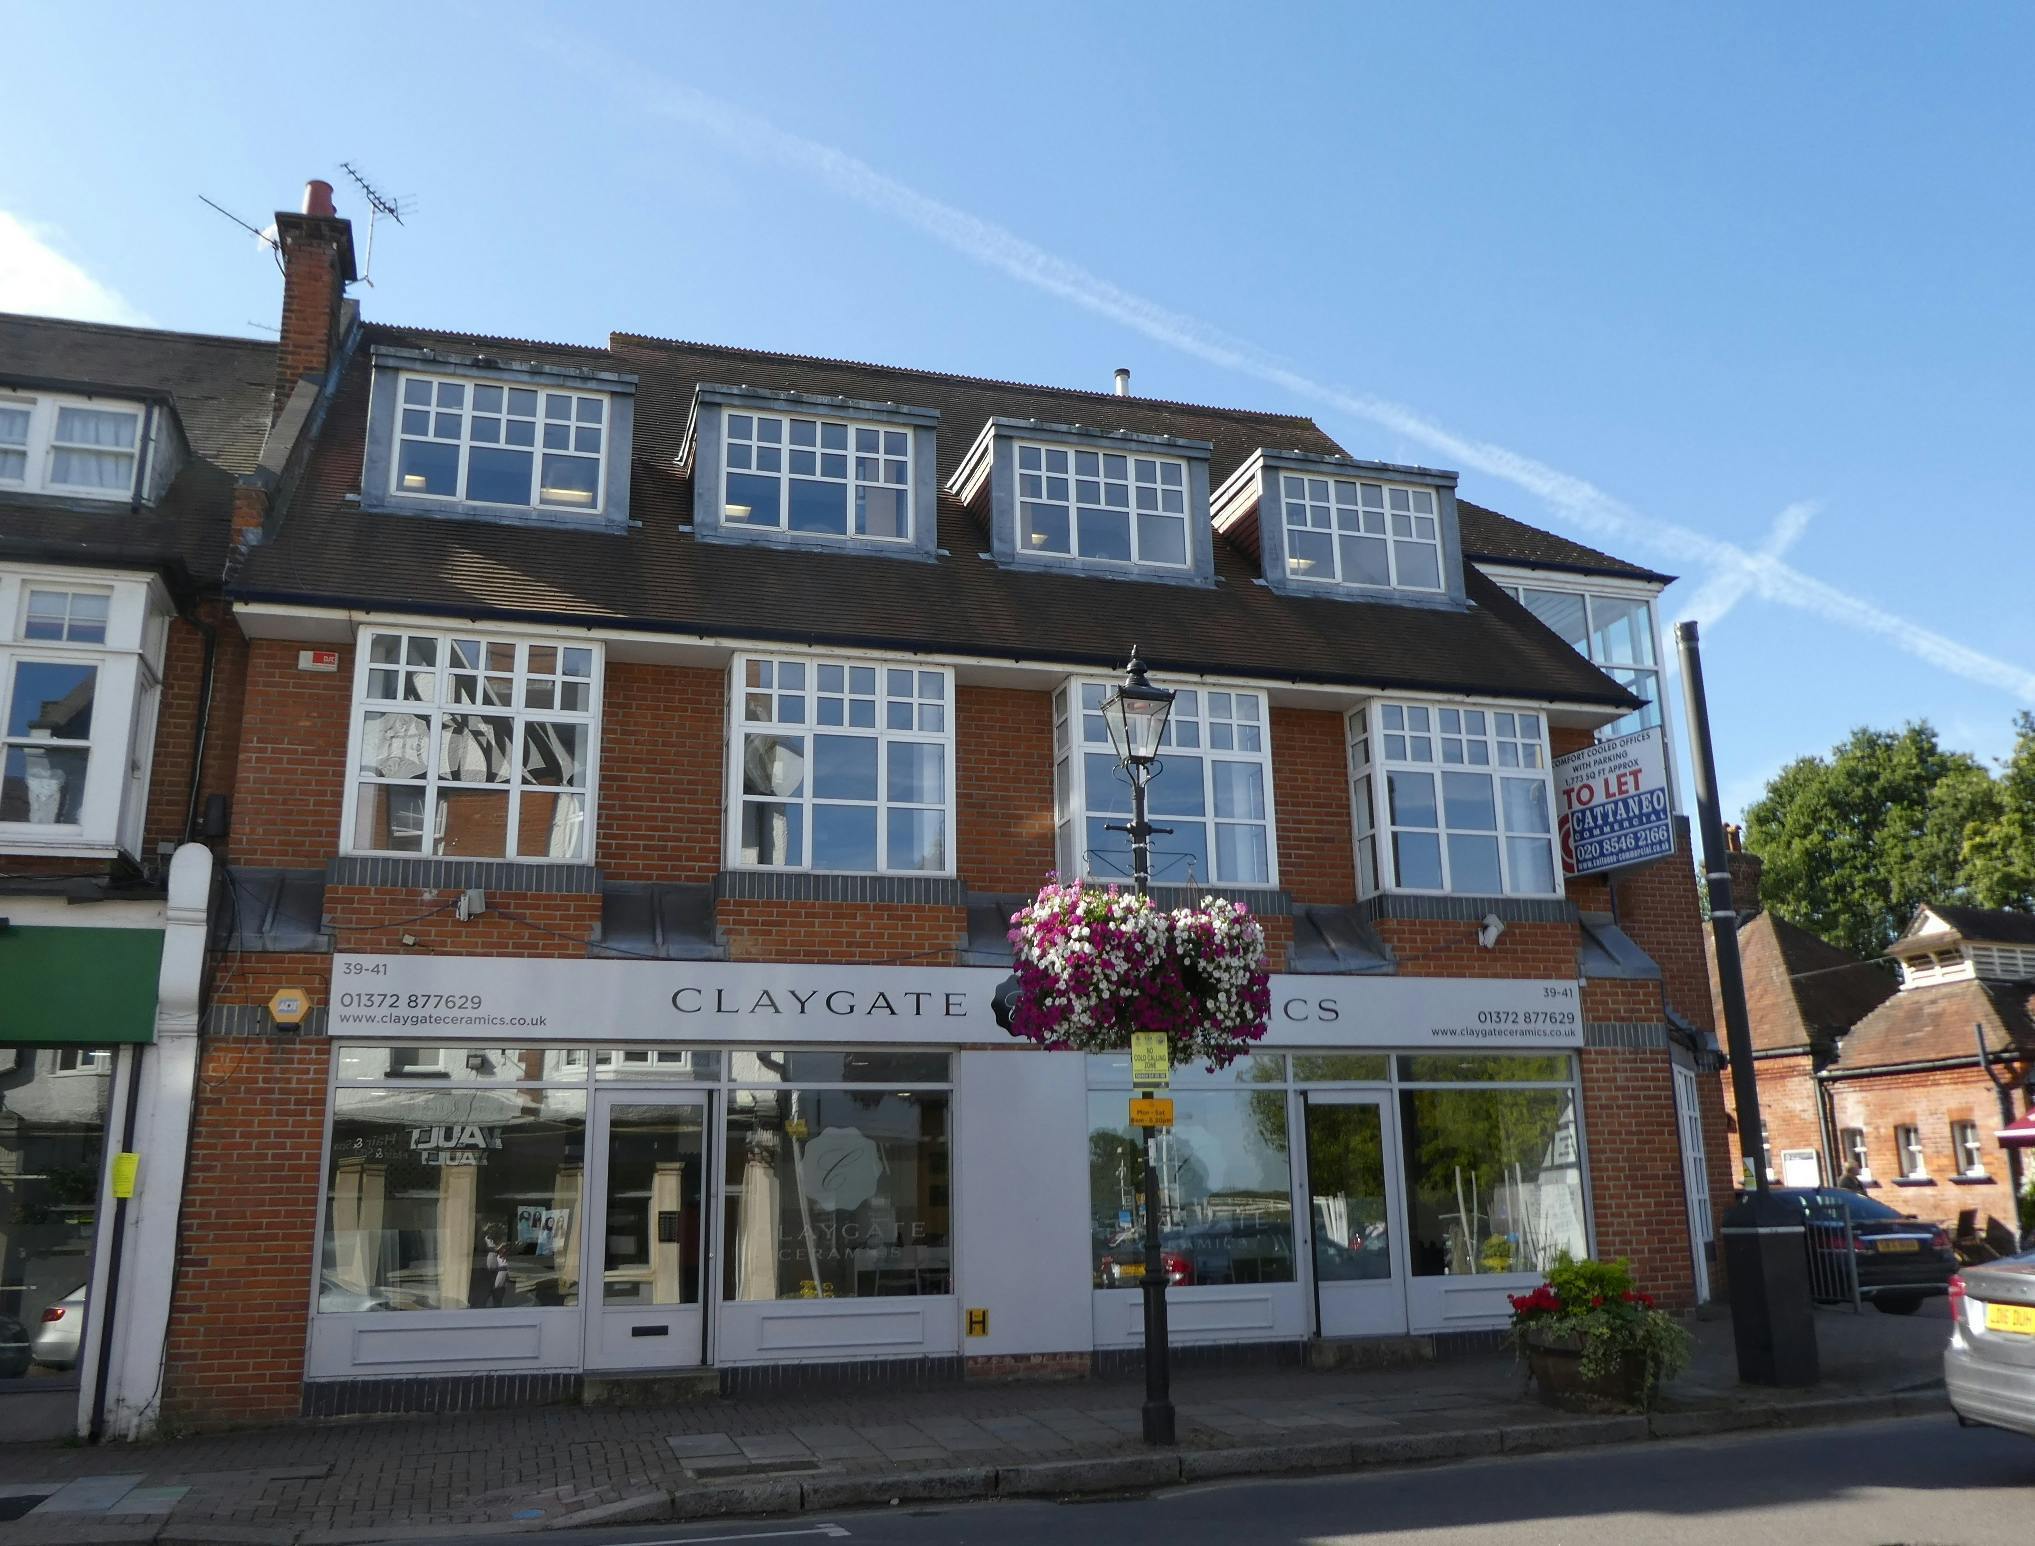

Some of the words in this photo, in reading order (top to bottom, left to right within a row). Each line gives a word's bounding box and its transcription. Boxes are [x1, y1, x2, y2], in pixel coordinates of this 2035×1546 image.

[1552, 751, 1585, 769] COMFORT
[1587, 743, 1617, 759] COOLED
[1619, 732, 1651, 748] OFFICES
[1572, 761, 1592, 773] WITH
[1593, 750, 1628, 766] PARKING
[1585, 771, 1596, 781] SQ
[1597, 767, 1606, 777] FT
[1608, 758, 1640, 774] APPROX
[1562, 783, 1595, 810] TO
[1603, 768, 1643, 799] LET
[1572, 790, 1665, 832] CATTANEO
[1575, 812, 1667, 841] COMMERCIAL
[1577, 843, 1600, 860] 020
[1603, 834, 1635, 853] 8546
[1638, 825, 1668, 846] 2166
[343, 962, 388, 976] 39-41
[340, 993, 400, 1009] 01372
[407, 994, 482, 1010] 877629
[671, 987, 968, 1017] CLAYGATE
[1543, 987, 1573, 998] 39-41
[339, 1012, 547, 1027] www.claygateceramics.co.uk
[1477, 1011, 1519, 1024] 01372
[1523, 1011, 1575, 1025] 877629
[1431, 1026, 1576, 1038] www.claygateceramics.co.uk
[969, 1310, 986, 1335] H
